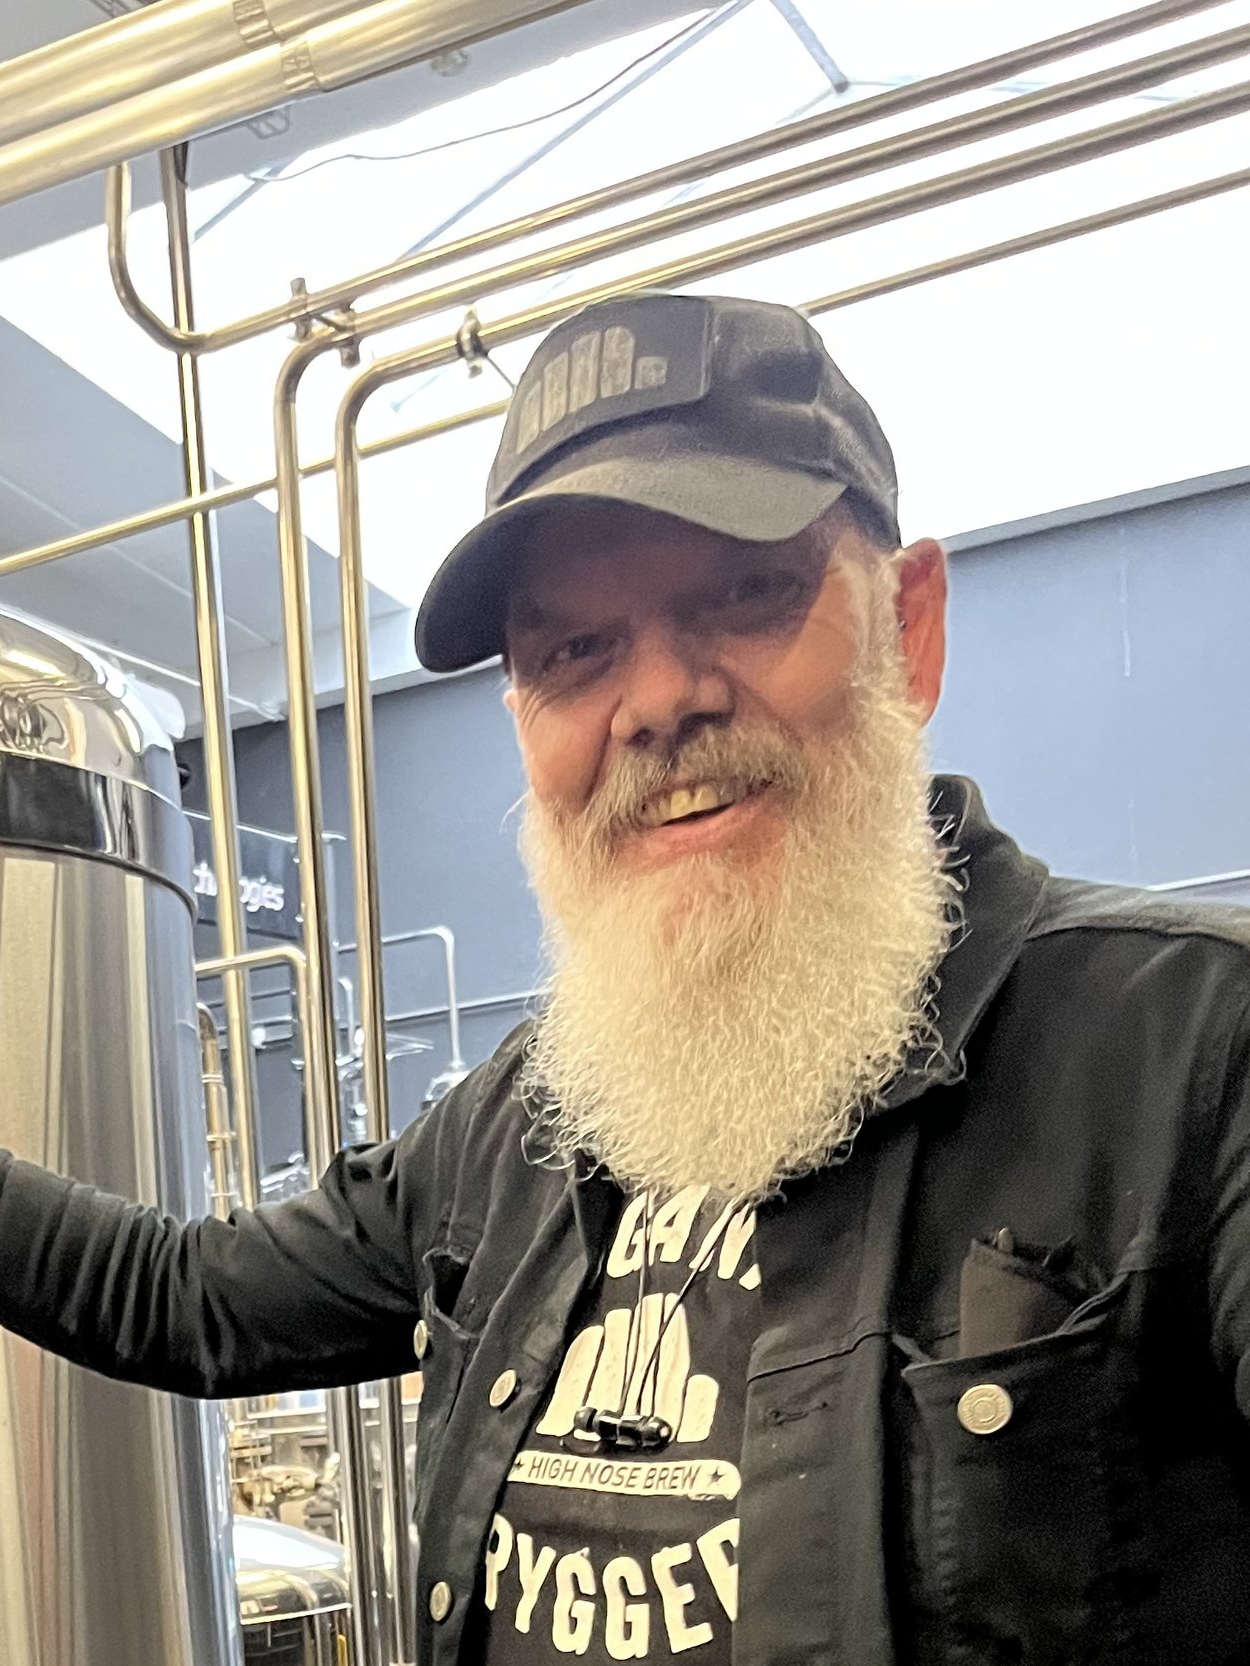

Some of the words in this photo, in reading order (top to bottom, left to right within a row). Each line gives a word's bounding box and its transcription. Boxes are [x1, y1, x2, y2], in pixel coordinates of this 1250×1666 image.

[527, 1456, 580, 1482] HIGH
[580, 1461, 642, 1488] NOSE
[643, 1465, 702, 1490] BREW
